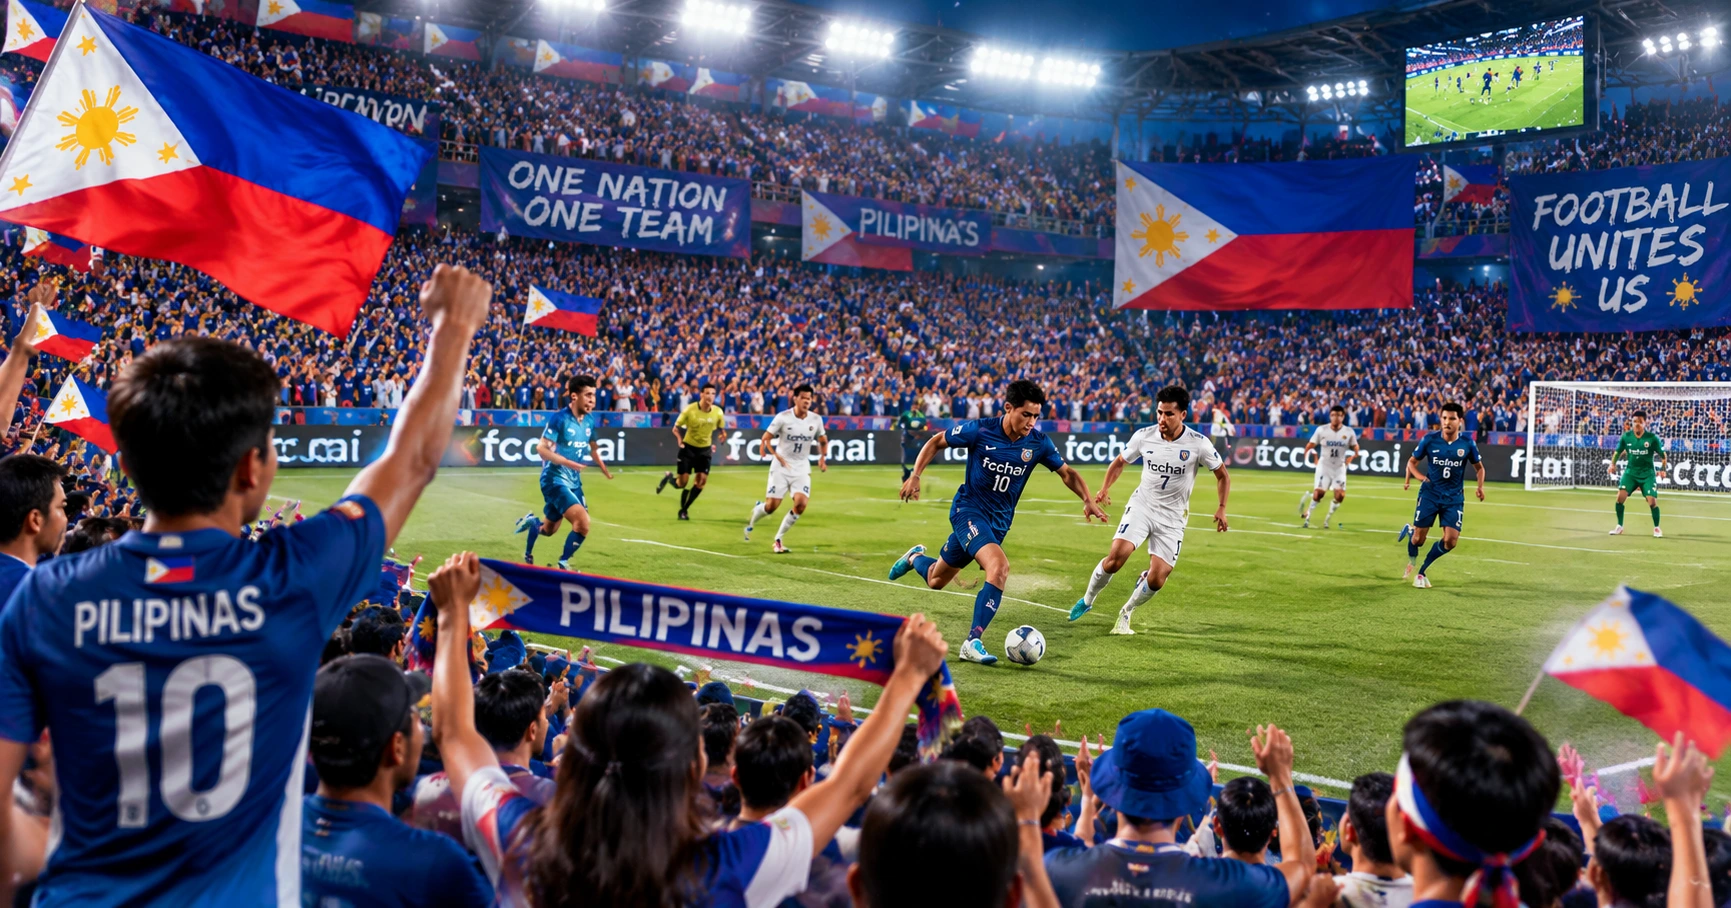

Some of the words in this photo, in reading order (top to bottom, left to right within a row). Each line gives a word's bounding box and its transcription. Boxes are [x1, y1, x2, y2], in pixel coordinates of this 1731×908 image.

[508, 160, 586, 196] ONE
[597, 172, 727, 212] NATION
[1532, 181, 1729, 231] FOOTBALL
[524, 195, 603, 232] ONE
[617, 206, 713, 246] TEAM
[1549, 223, 1706, 274] UNITES
[1598, 274, 1650, 314] US
[982, 457, 1027, 476] fcchai
[993, 475, 1010, 492] 10
[1147, 460, 1186, 475] fcchai
[1160, 475, 1170, 490] 7
[1442, 466, 1451, 479] 6
[74, 585, 266, 648] PILIPINAS
[560, 582, 823, 662] PILIPINAS
[94, 654, 257, 829] 10
